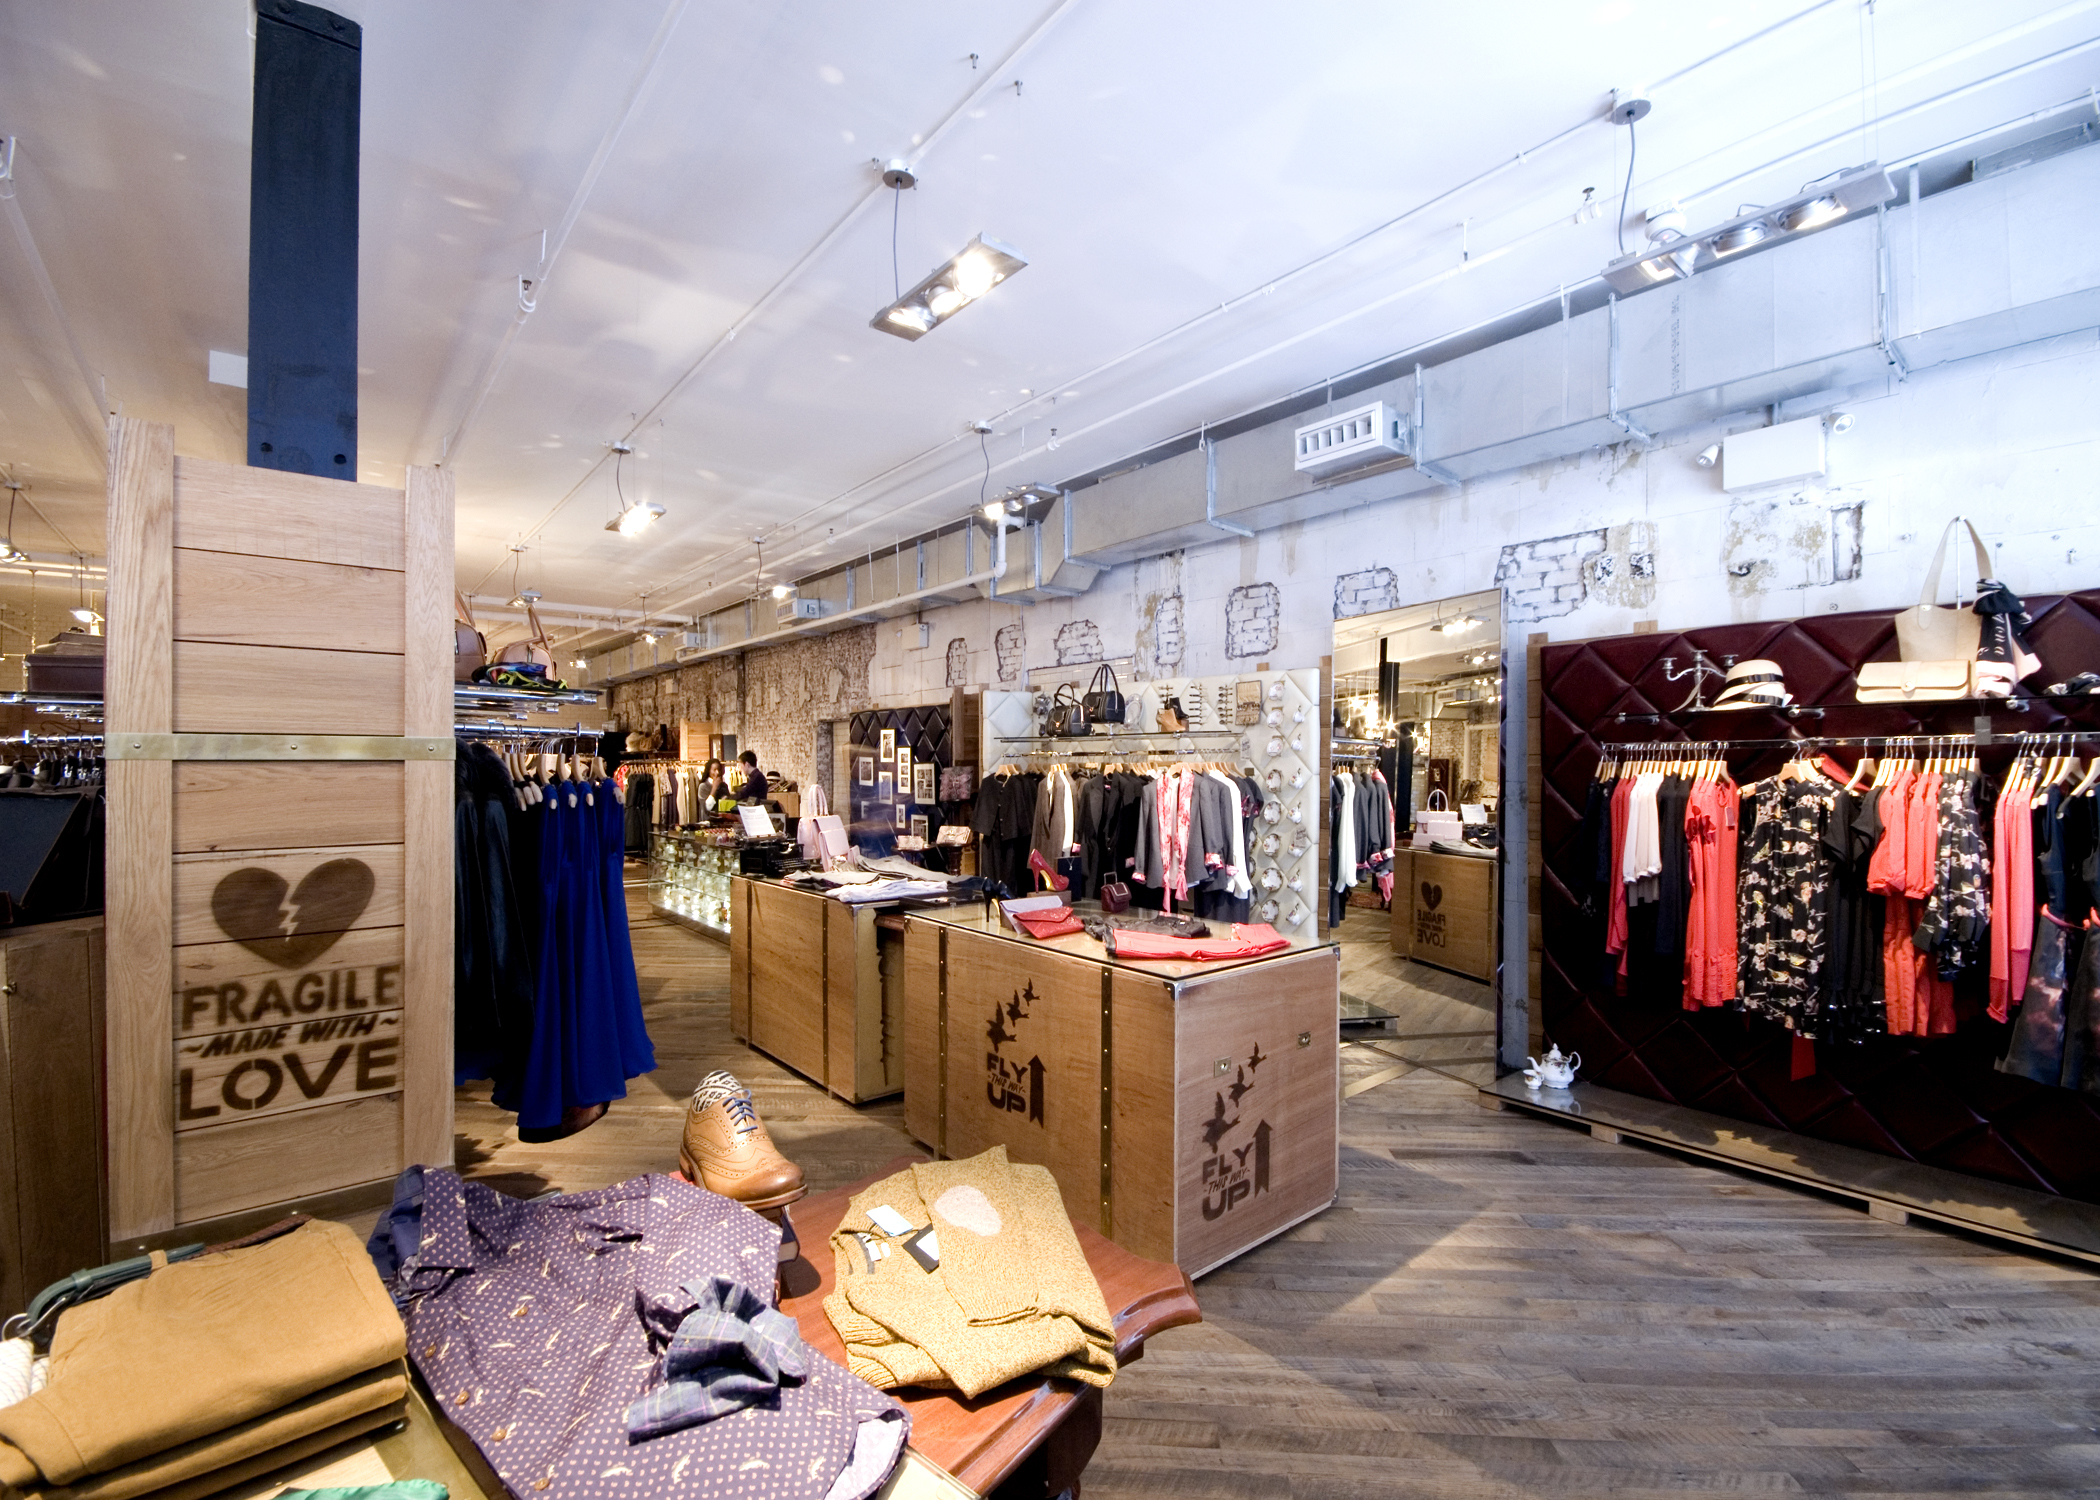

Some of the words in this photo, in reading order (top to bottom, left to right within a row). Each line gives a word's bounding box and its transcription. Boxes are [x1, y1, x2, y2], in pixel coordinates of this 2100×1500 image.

[181, 964, 400, 1032] FRAGILE
[201, 1025, 293, 1058] MADE
[299, 1014, 379, 1044] WITH
[179, 1036, 400, 1121] LOVE
[987, 1052, 1028, 1084] FLY
[992, 1073, 1008, 1088] THIS
[1008, 1081, 1024, 1094] WAY
[987, 1082, 1027, 1114] UP
[1203, 1141, 1254, 1185] FLY
[1208, 1175, 1229, 1194] THIS
[1229, 1167, 1248, 1185] WAY
[1202, 1179, 1251, 1221] UP
